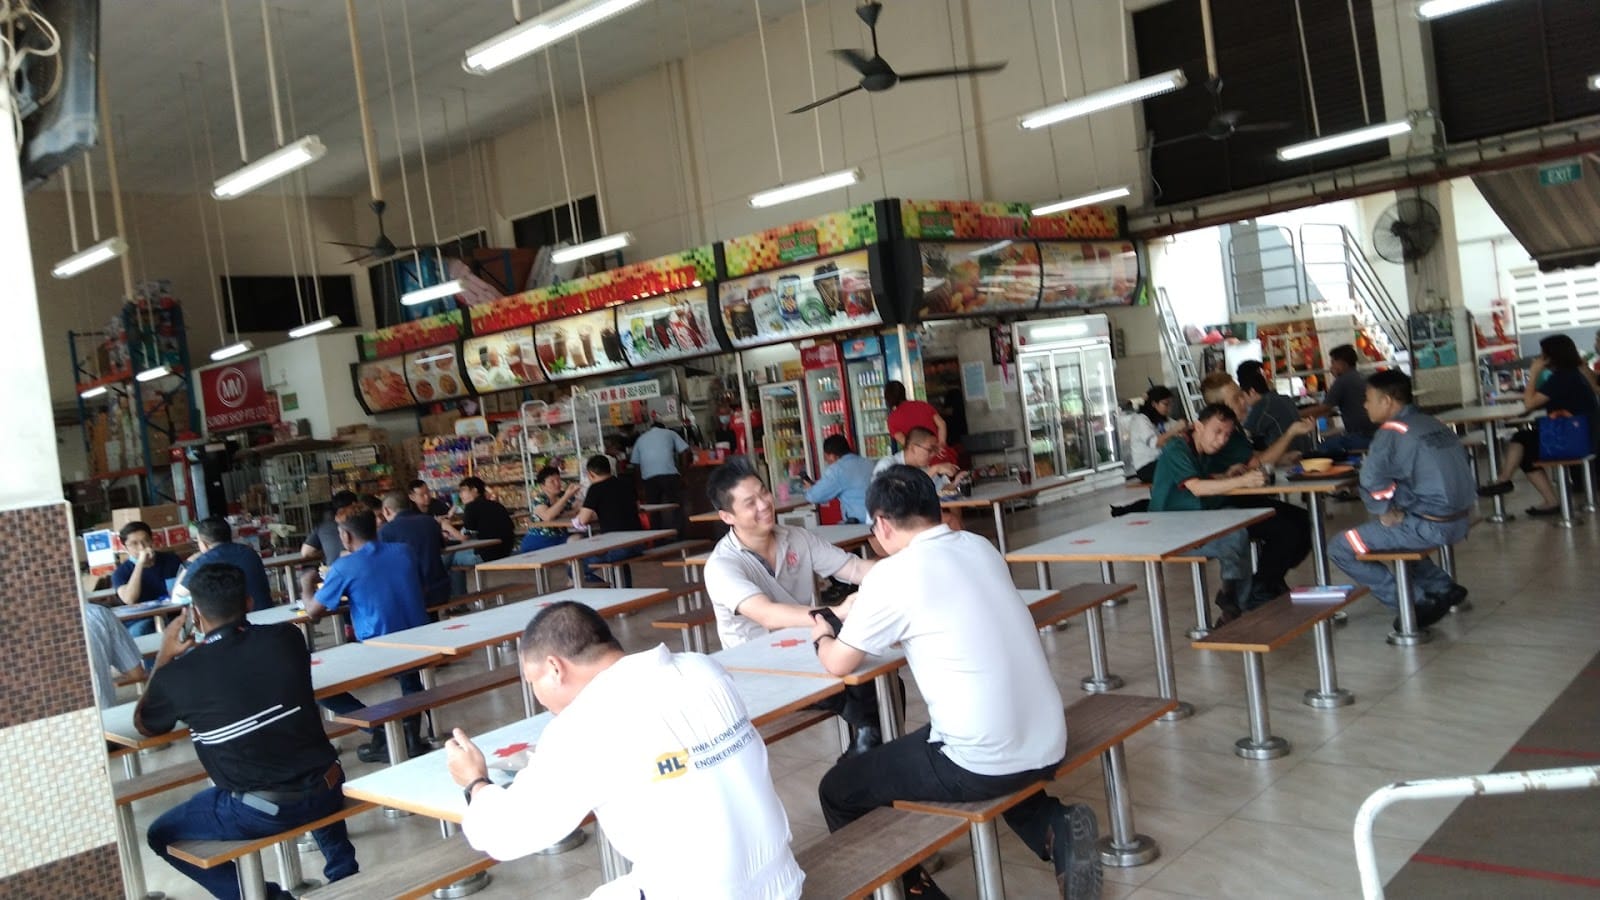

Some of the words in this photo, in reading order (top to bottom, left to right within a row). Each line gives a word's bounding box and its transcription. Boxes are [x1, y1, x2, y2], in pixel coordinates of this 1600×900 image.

[1547, 167, 1572, 183] EXIT
[691, 742, 710, 754] HWA
[710, 727, 734, 746] LEONG
[694, 739, 743, 769] ENGINEERING
[657, 756, 686, 776] HL
